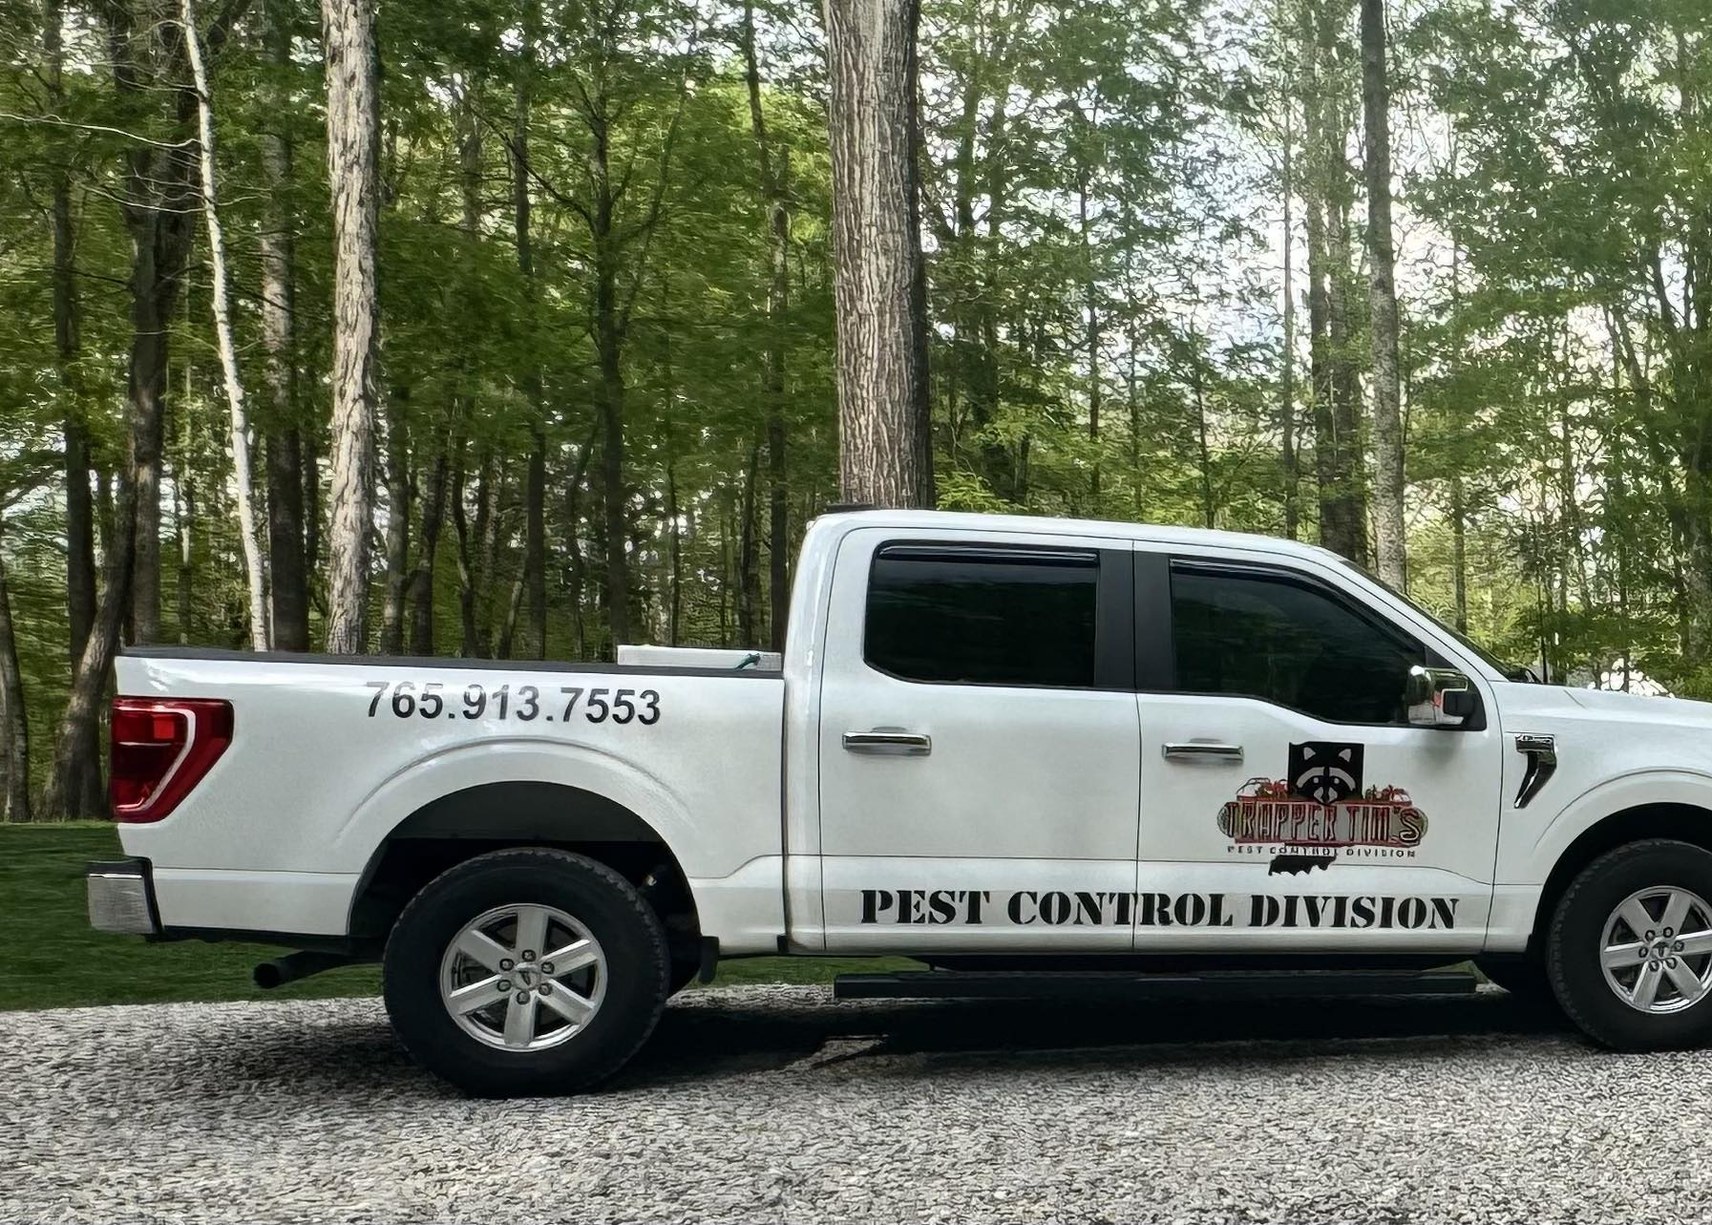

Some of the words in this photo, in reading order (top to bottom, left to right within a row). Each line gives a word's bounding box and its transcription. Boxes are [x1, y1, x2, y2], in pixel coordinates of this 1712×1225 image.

[366, 681, 660, 726] 765.913.7553
[1225, 802, 1337, 841] TRAPPER
[1347, 805, 1421, 845] TIM'S
[1227, 846, 1262, 854] PEST
[1270, 846, 1338, 856] CONTROL
[1346, 848, 1415, 857] DIVISION
[861, 890, 990, 924] PEST
[1007, 891, 1232, 926] CONTROL
[1248, 894, 1459, 929] DIVISION
